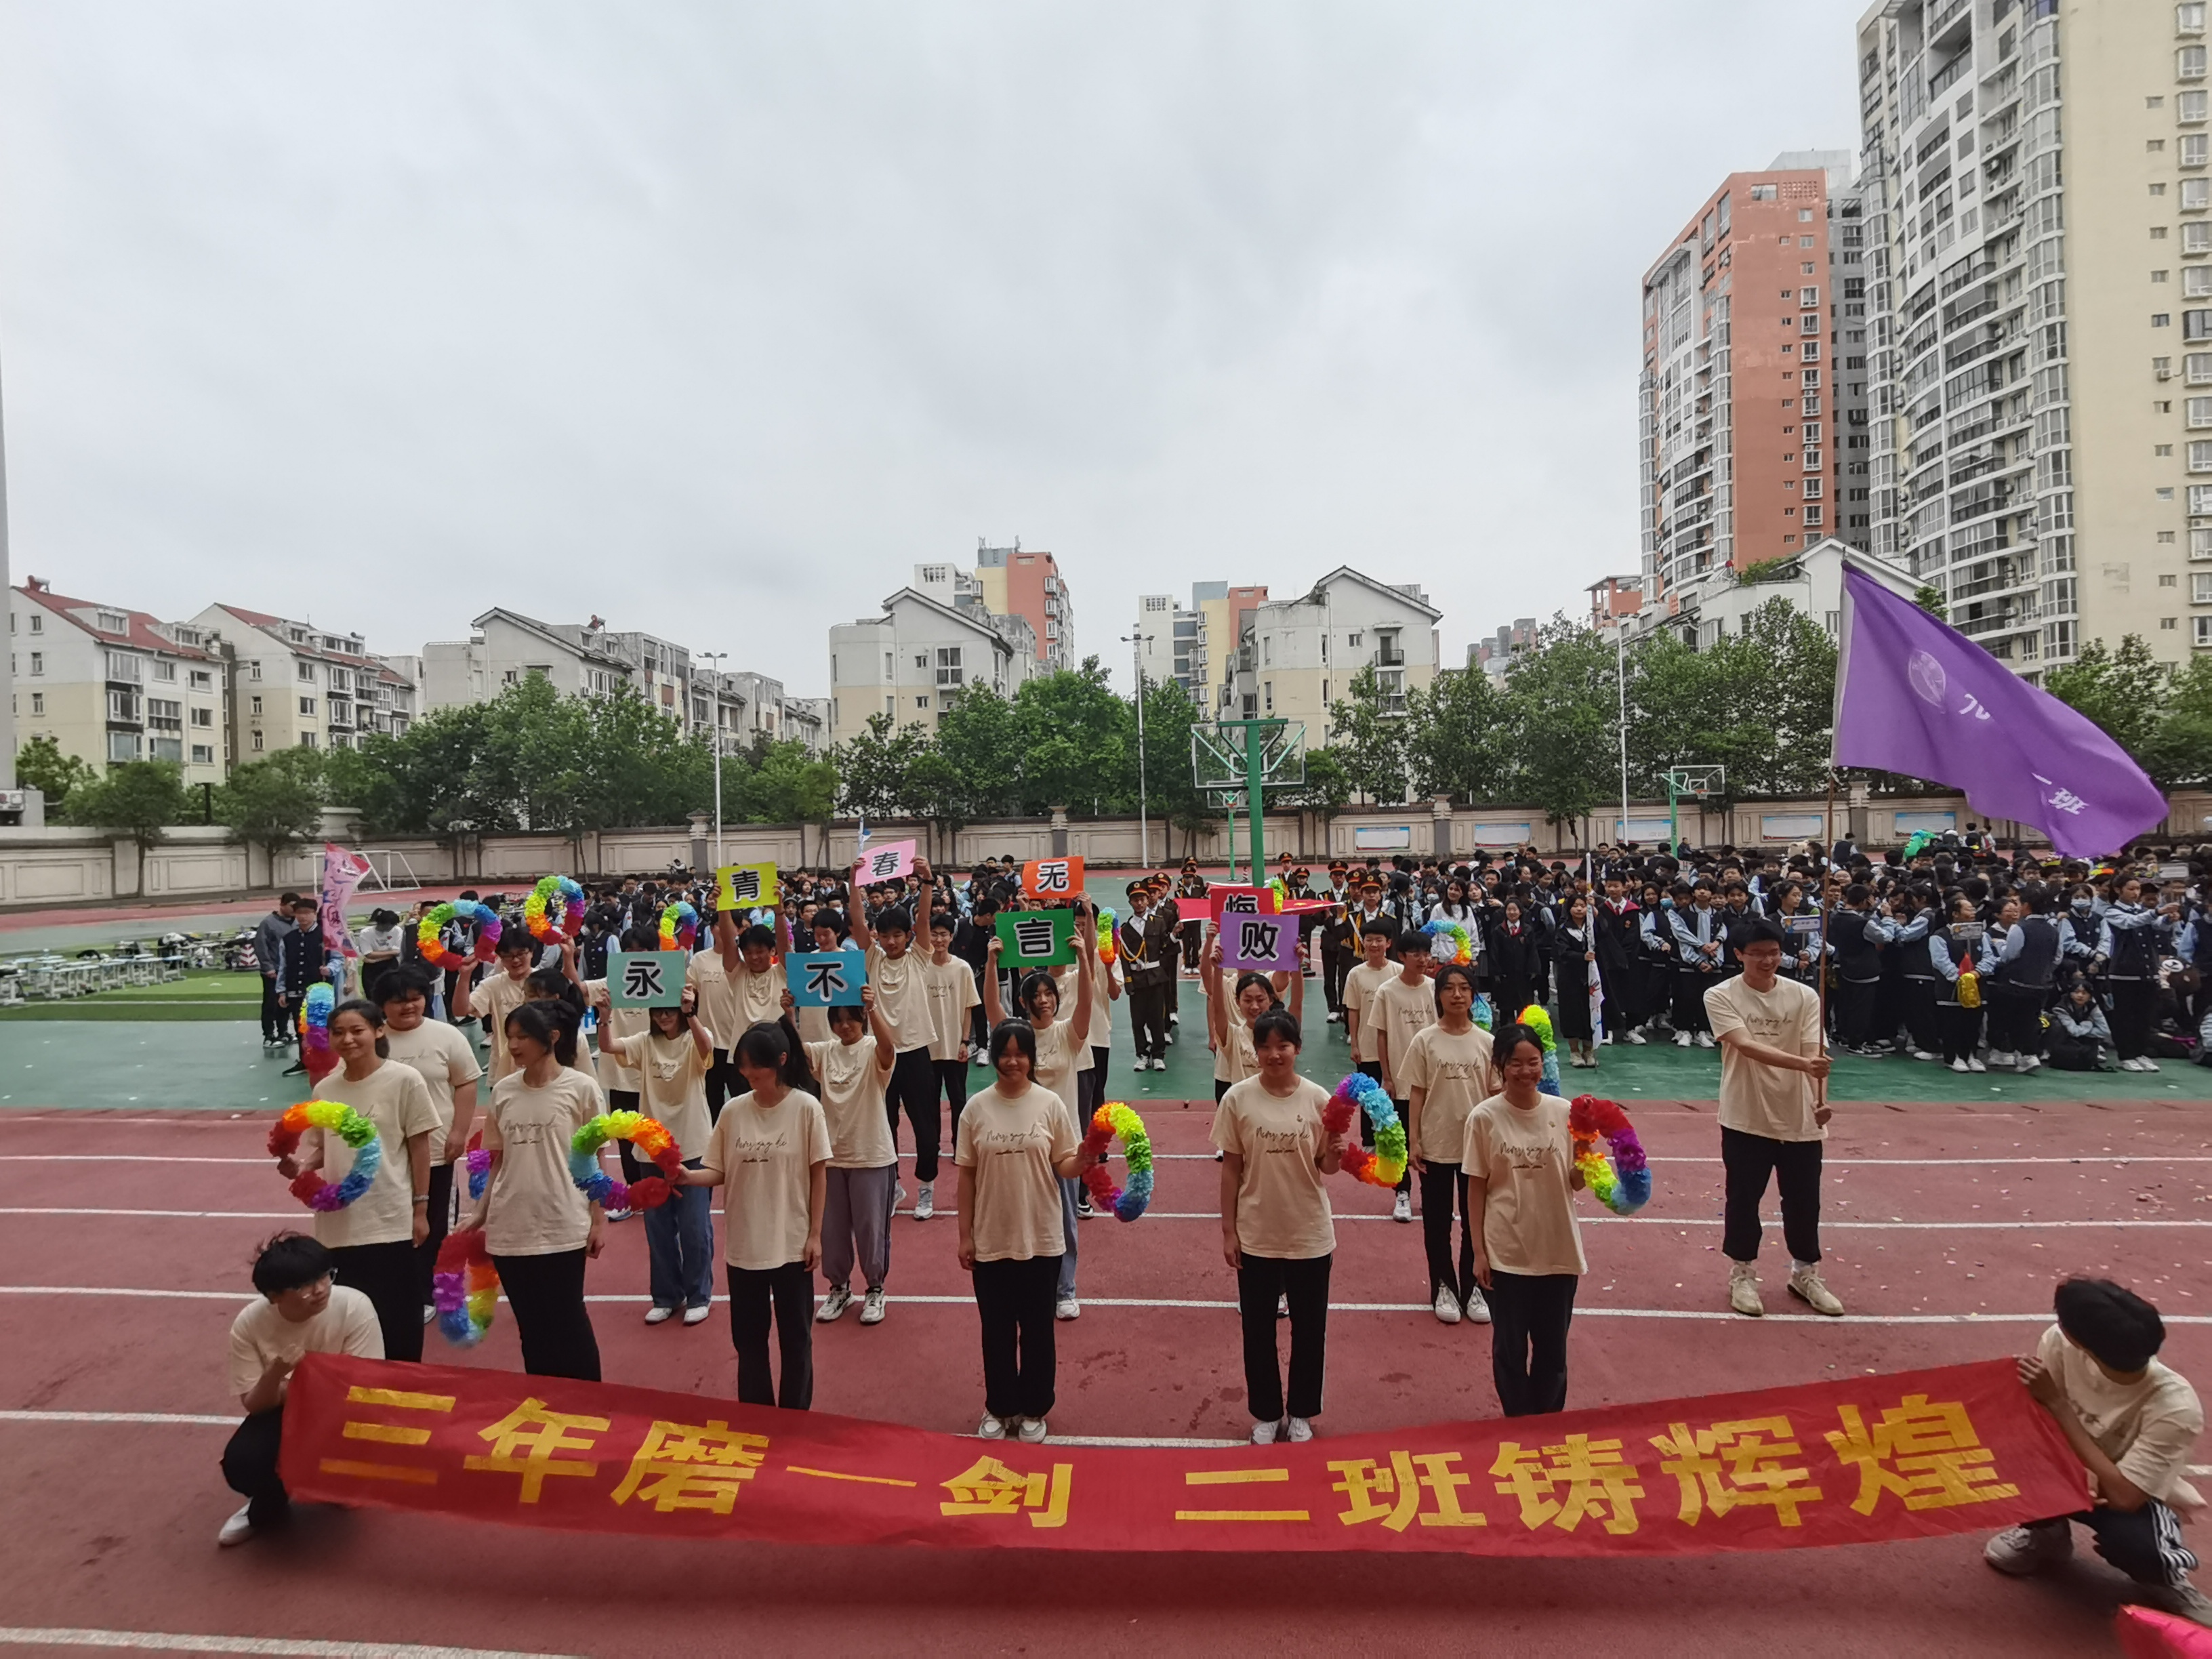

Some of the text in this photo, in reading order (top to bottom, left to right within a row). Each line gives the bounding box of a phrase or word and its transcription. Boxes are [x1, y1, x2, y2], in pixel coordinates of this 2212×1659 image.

[872, 851, 900, 877] 春
[1038, 863, 1068, 891] 无
[731, 870, 760, 900] 青
[1014, 918, 1054, 955] 言
[1240, 921, 1278, 959] 败
[625, 961, 663, 997] 永
[806, 962, 844, 998] 不
[319, 1385, 2022, 1535] 三年磨一剑 二班铸辉煌
